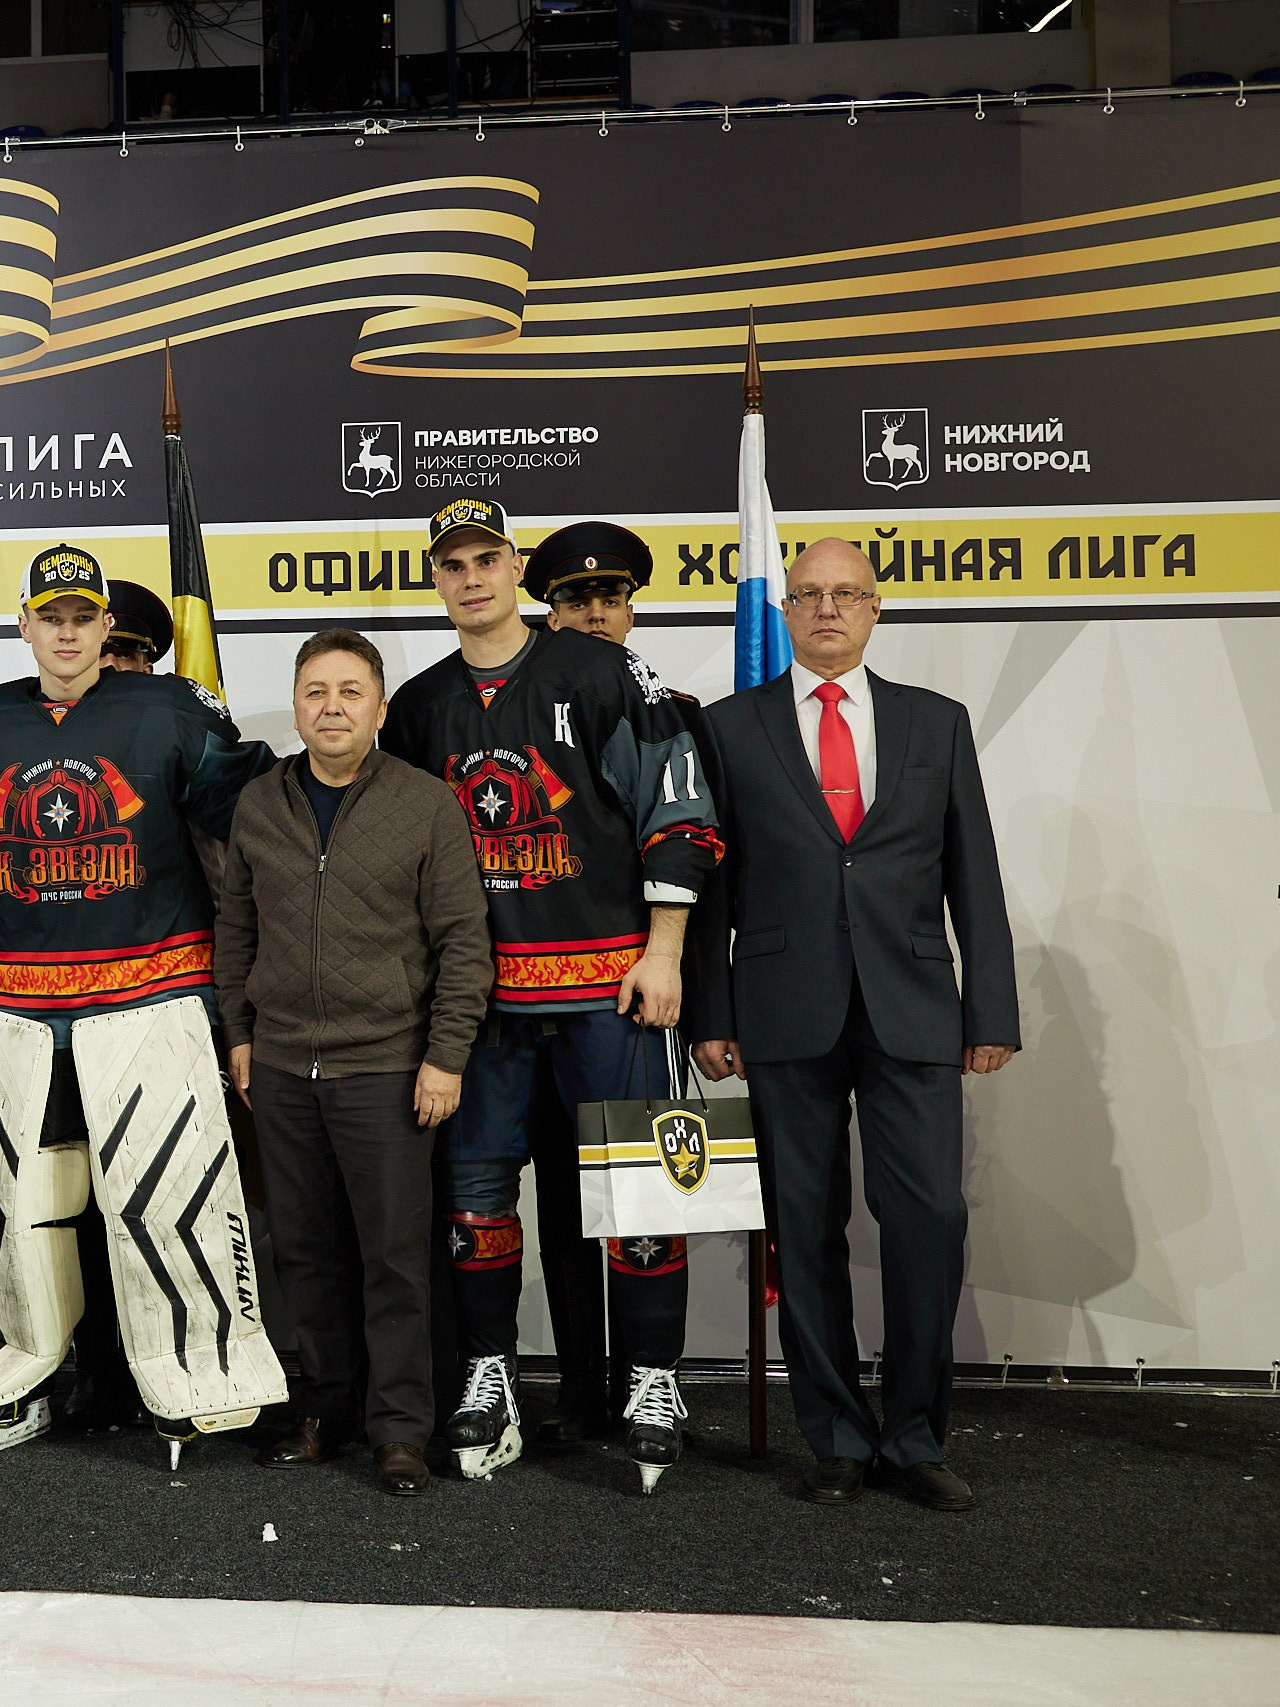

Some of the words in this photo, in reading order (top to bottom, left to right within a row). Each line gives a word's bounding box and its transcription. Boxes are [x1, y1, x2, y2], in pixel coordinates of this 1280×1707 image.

[414, 426, 599, 447] ПРАВИТЕЛЬСТВО
[944, 417, 1064, 445] НИЖНИЙ
[415, 449, 581, 470] НИЖЕГОРОДСКОЙ
[944, 450, 1091, 473] НОВГОРОД
[414, 472, 501, 488] ОБЛАСТИ
[440, 516, 451, 530] 20
[473, 510, 487, 521] 25
[678, 527, 1022, 585] ХОЙНАЯ
[1048, 534, 1196, 580] ЛИГА
[44, 570, 57, 583] 20
[78, 569, 91, 581] 25
[21, 758, 53, 783] НИЖНИЙ
[63, 758, 98, 781] НОВГОРОД
[493, 748, 528, 772] НОВГОРОД
[662, 750, 703, 804] 11
[41, 891, 58, 902] МЧС
[60, 889, 82, 901] РОССИИ
[491, 879, 519, 890] РОССИИ
